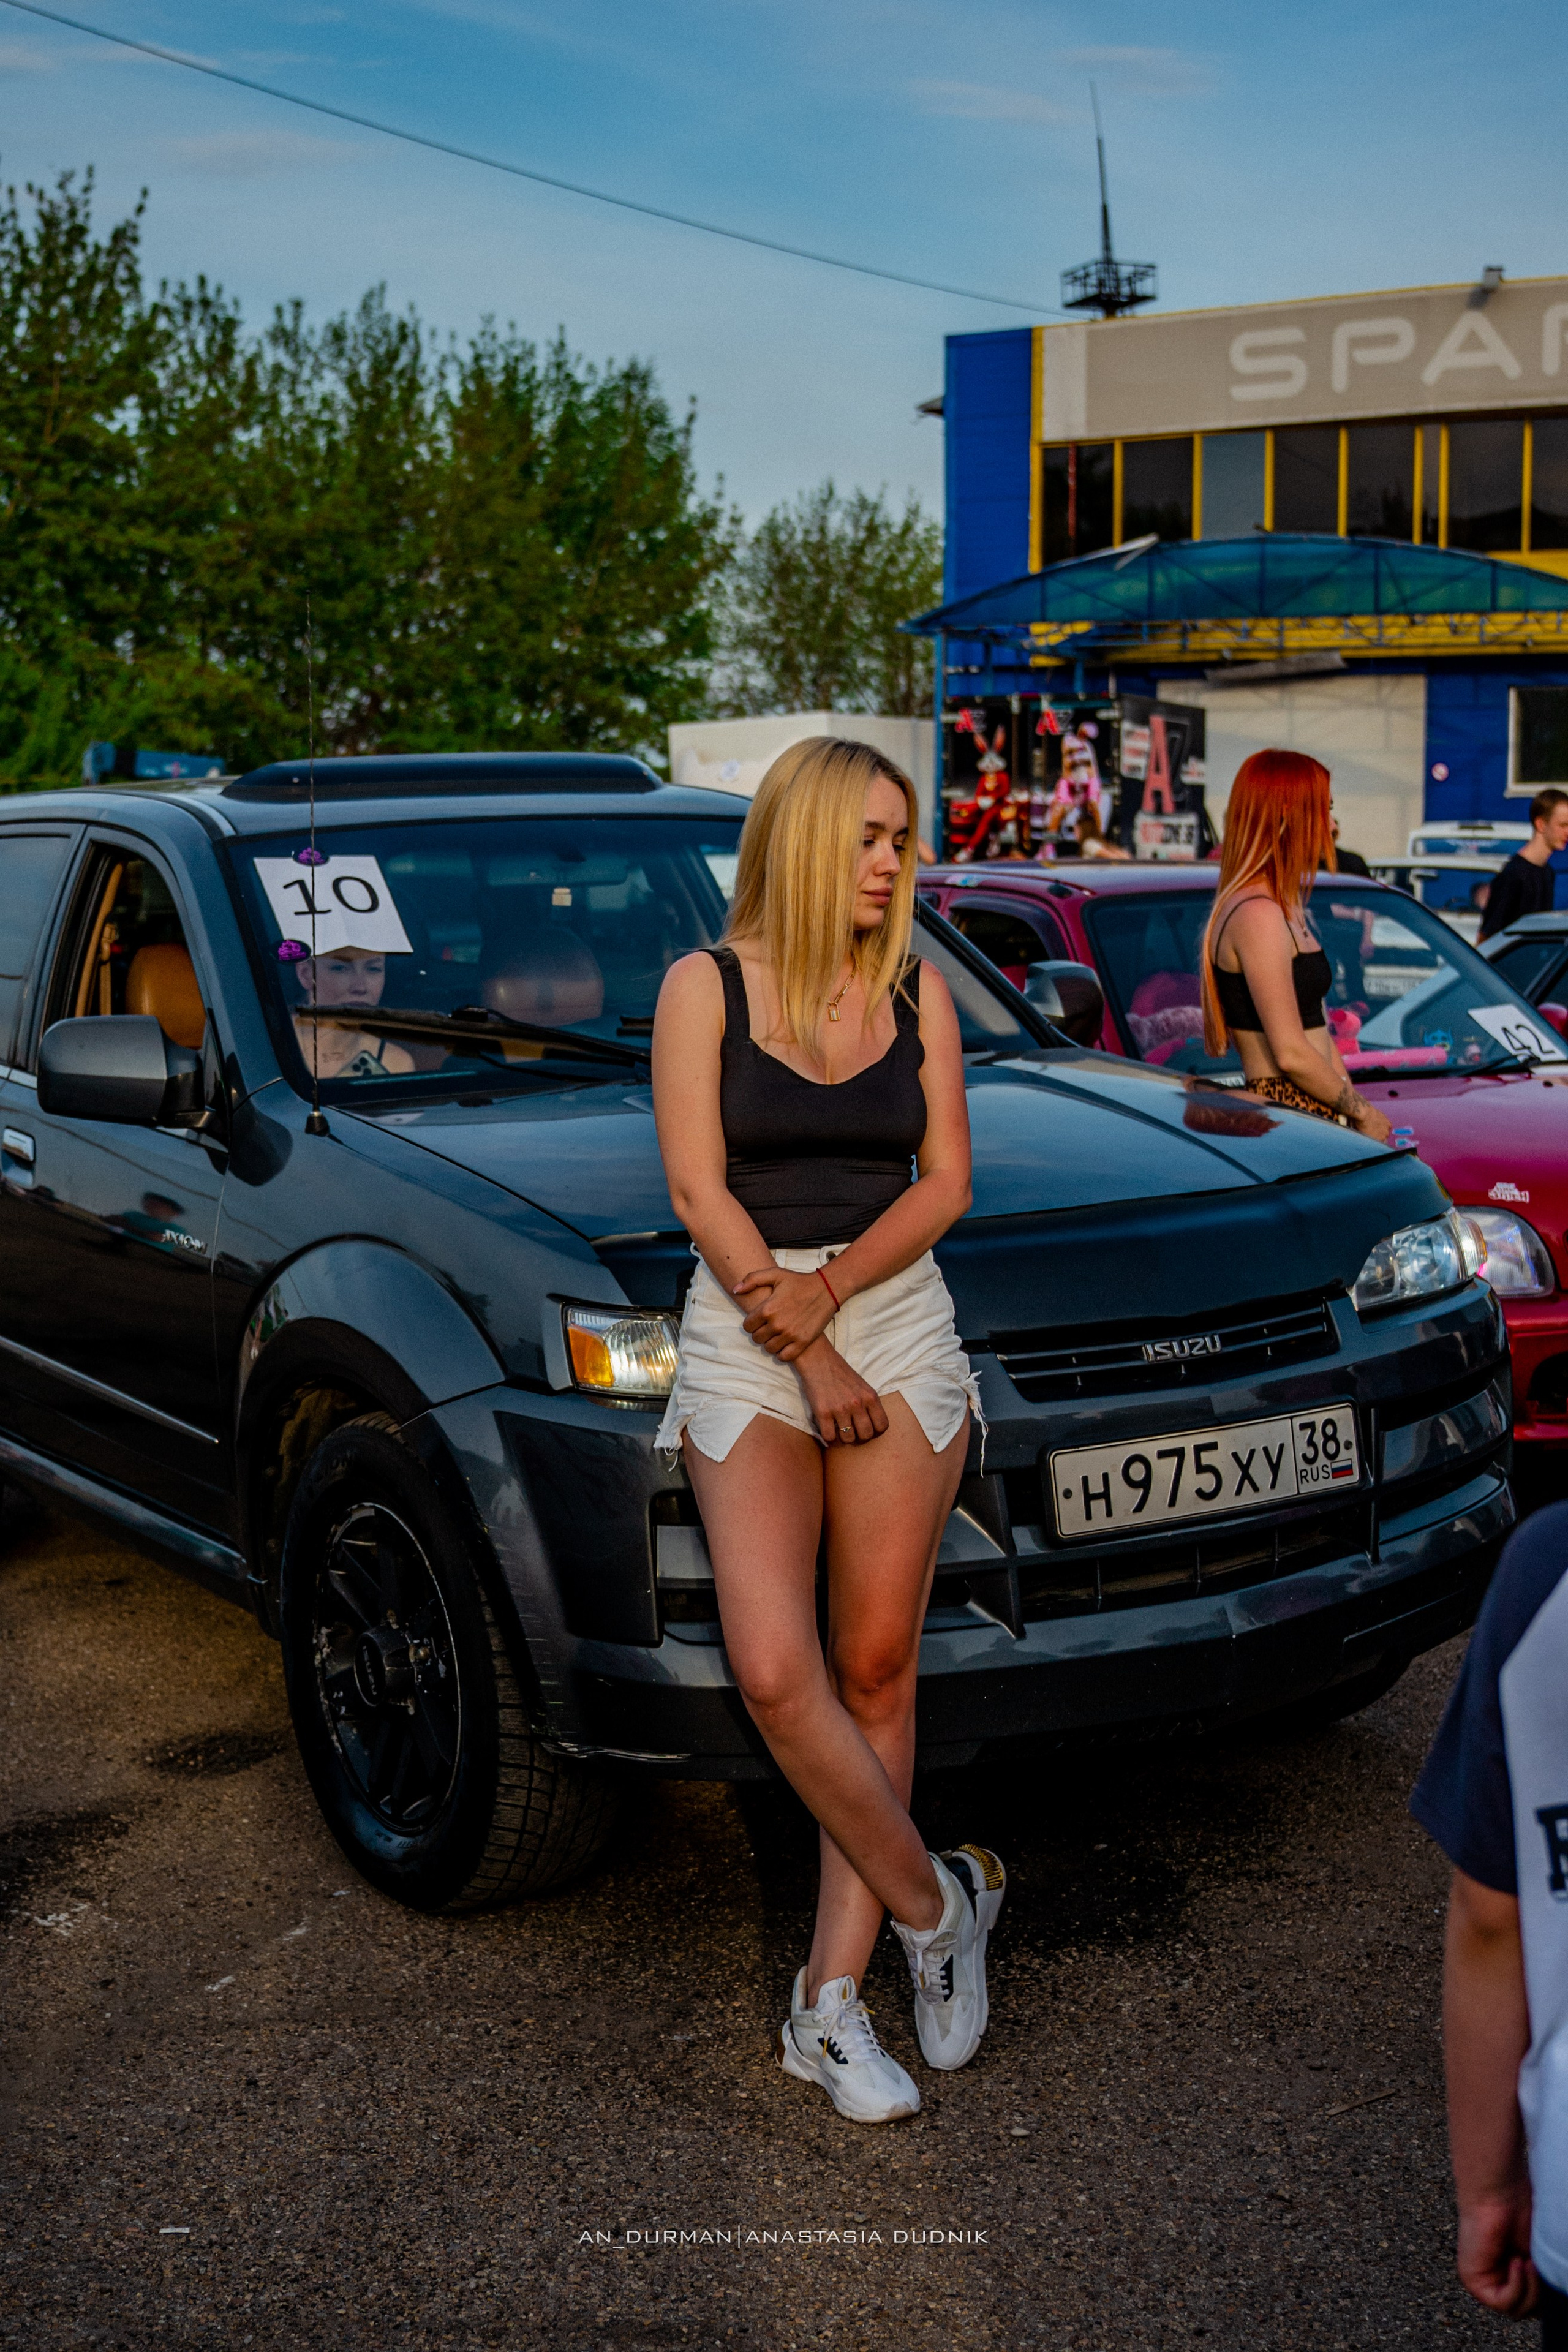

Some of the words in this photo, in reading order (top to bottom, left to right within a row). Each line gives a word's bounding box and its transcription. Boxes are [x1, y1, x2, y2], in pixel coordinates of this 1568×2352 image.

[282, 875, 380, 916] 10
[1501, 1024, 1555, 1057] 42
[1143, 1334, 1223, 1362] ISUZU
[1297, 1417, 1341, 1465] 38
[1300, 1463, 1331, 1485] RUS
